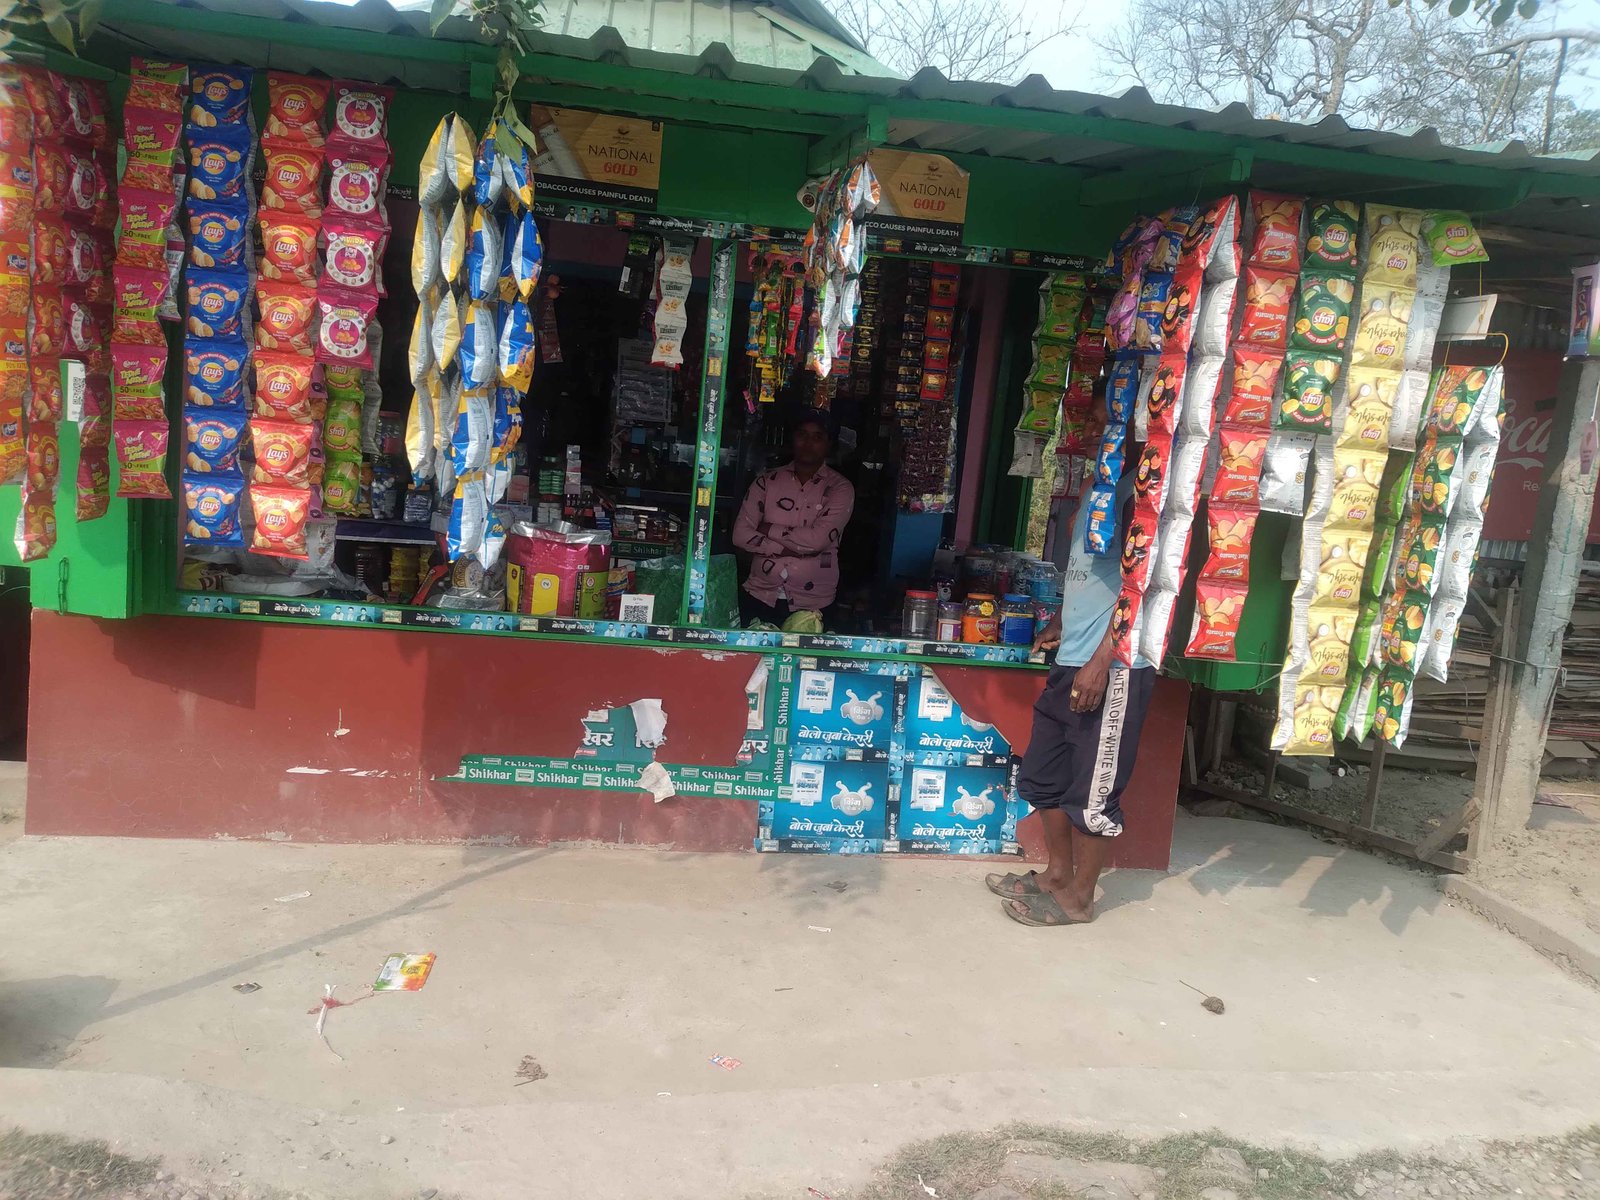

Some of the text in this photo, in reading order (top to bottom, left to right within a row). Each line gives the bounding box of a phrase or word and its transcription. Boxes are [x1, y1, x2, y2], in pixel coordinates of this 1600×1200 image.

[588, 144, 655, 164] NATIONAL
[603, 162, 638, 177] GOLD
[534, 181, 654, 203] TOBACCO CAUSES PAINFUL DEATH
[900, 182, 962, 199] NATIONAL
[913, 198, 946, 212] GOLD
[880, 222, 906, 232] CAUSES
[907, 225, 935, 235] PAINFUL
[936, 229, 959, 237] DEATH
[778, 686, 790, 725] Shikhar
[842, 728, 874, 748] केसरी
[962, 734, 994, 754] केसरी
[1101, 710, 1120, 769] OFF-WHITE
[469, 768, 512, 780] Shikhar
[537, 772, 579, 784] Shikhar
[604, 776, 640, 788] Shikh
[735, 785, 774, 796] Shikhar
[702, 770, 742, 781] Shikhar
[833, 818, 864, 838] केसरी
[955, 824, 986, 840] केसरी
